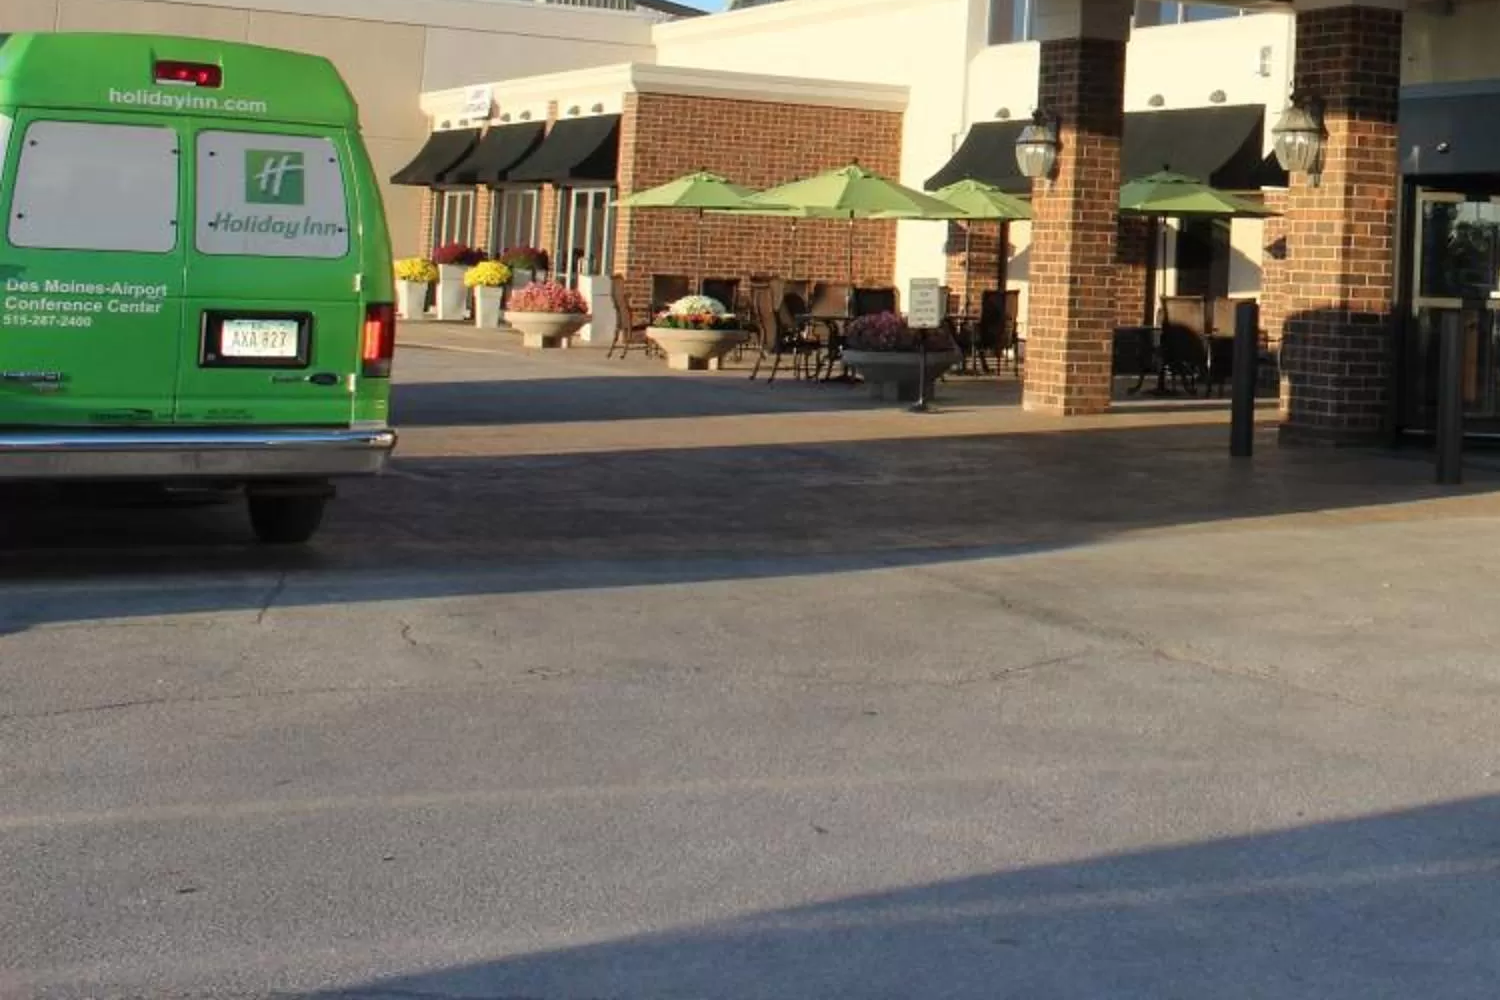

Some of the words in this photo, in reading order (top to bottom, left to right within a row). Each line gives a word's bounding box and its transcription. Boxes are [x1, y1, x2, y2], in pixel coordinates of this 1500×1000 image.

[212, 211, 300, 239] Holiday
[303, 215, 338, 237] Inn
[6, 277, 39, 293] Des
[44, 279, 168, 299] Moines-Airport
[5, 296, 103, 313] Conference
[107, 300, 162, 314] Center
